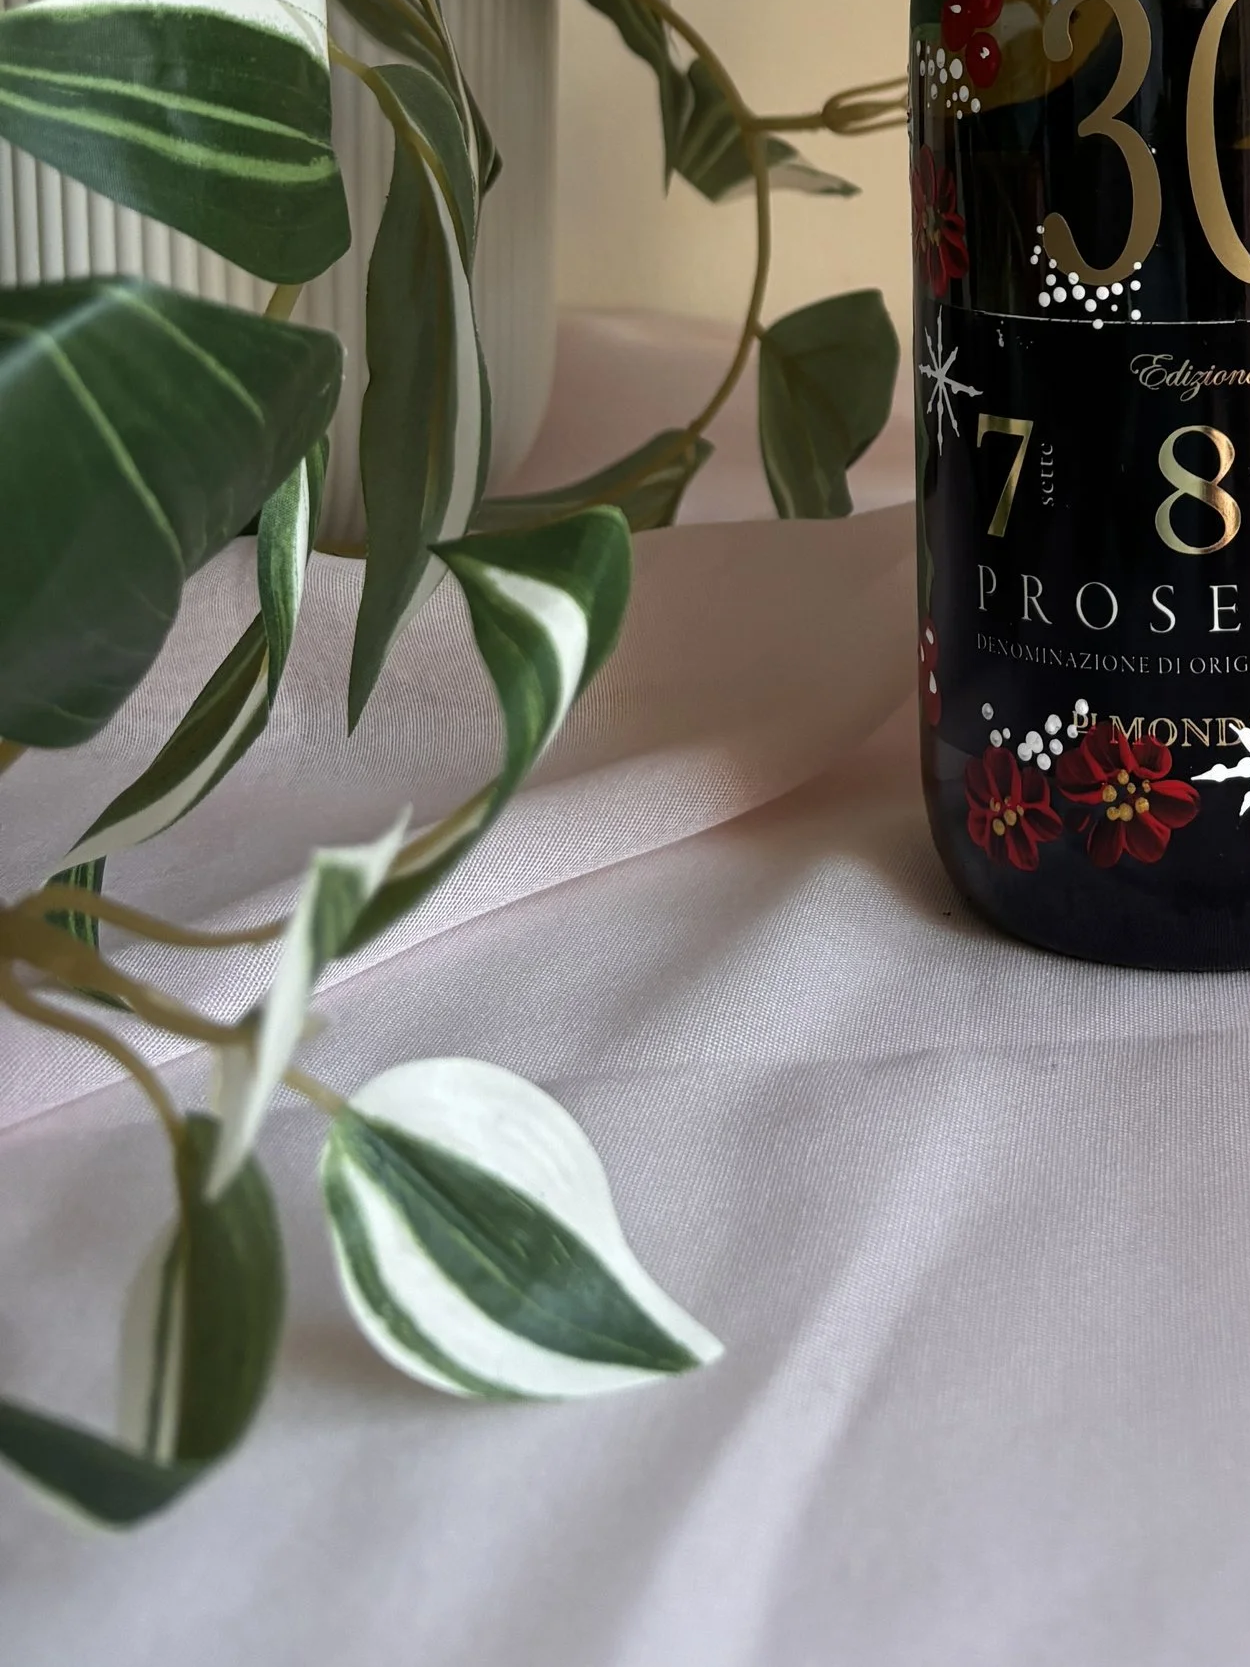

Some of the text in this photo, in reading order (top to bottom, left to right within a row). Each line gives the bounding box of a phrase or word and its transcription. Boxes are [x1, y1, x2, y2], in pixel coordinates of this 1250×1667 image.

[977, 413, 1034, 538] 7
[1155, 425, 1241, 555] 8
[1040, 442, 1054, 507] sette
[976, 633, 1150, 675] DENOMINAZIONE
[1158, 657, 1181, 675] DI
